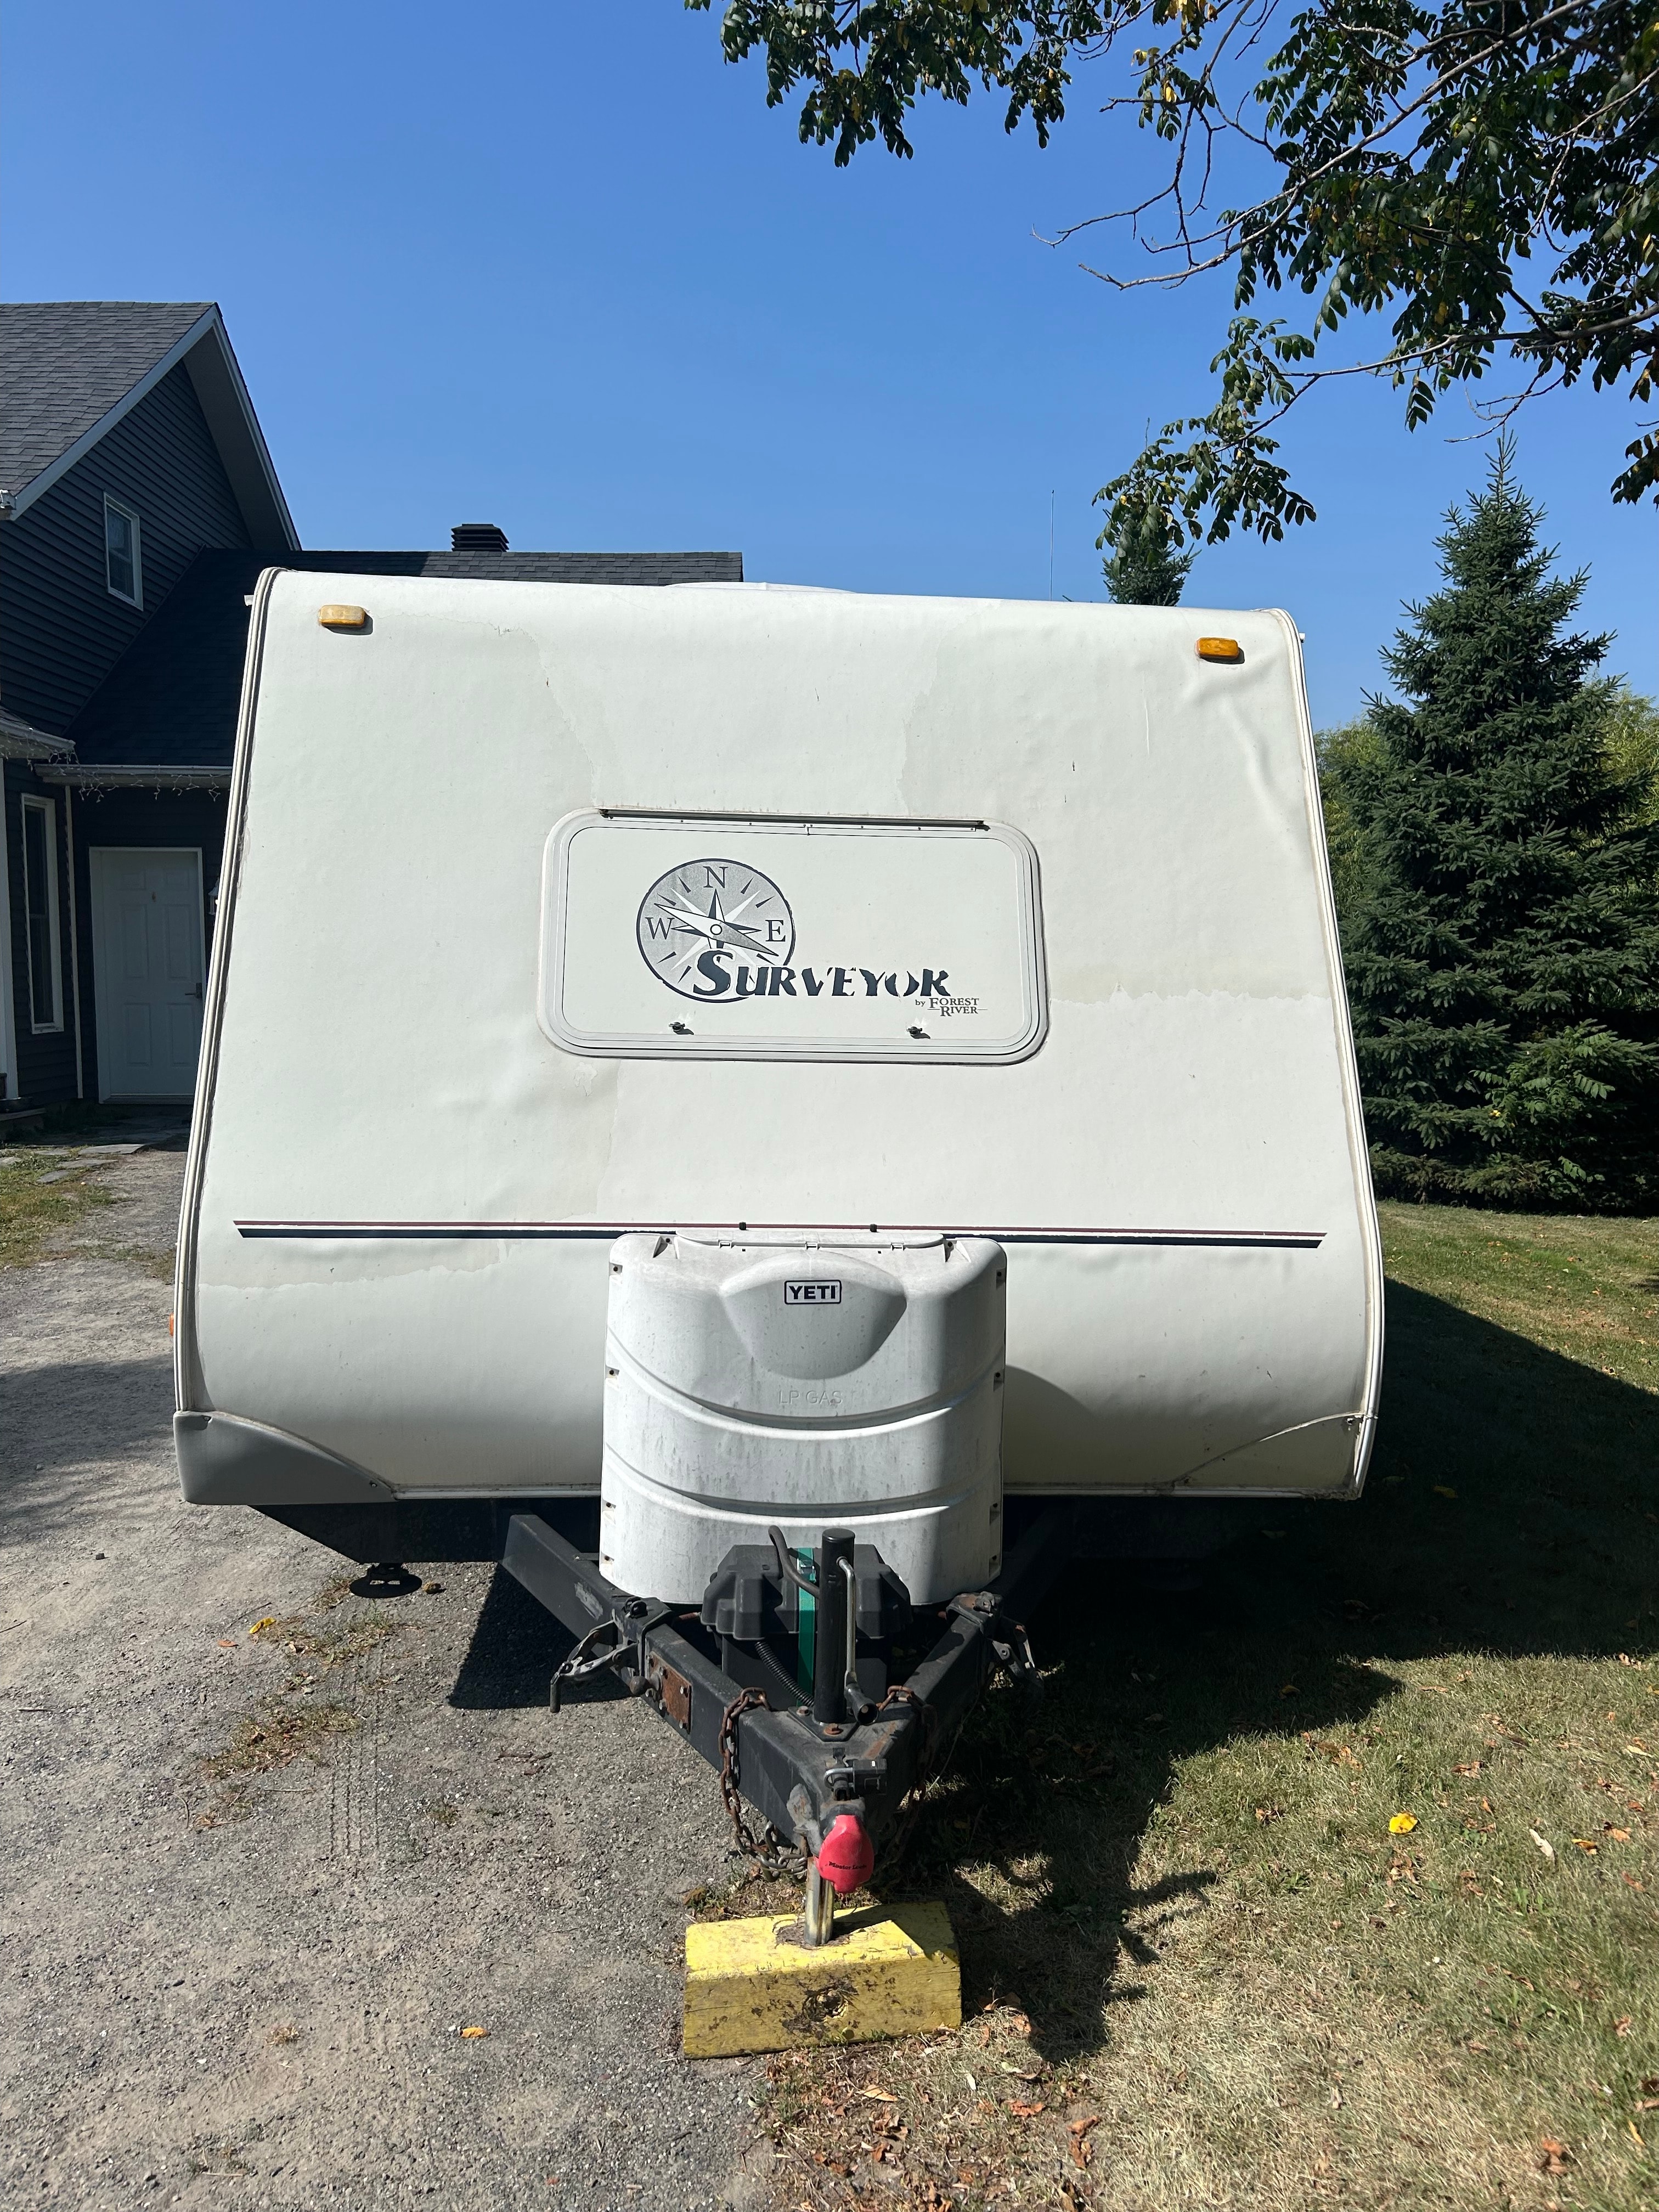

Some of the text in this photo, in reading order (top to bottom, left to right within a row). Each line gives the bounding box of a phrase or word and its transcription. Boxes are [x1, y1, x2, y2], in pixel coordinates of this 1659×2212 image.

[703, 866, 729, 888] N
[645, 917, 675, 940] W
[765, 919, 786, 941] E
[693, 950, 951, 997] SURVEYOR
[929, 997, 979, 1008] FOREST
[940, 1006, 978, 1017] RIVER
[788, 1285, 836, 1300] YETI
[779, 1390, 843, 1405] LP GAS
[829, 1861, 851, 1870] Master
